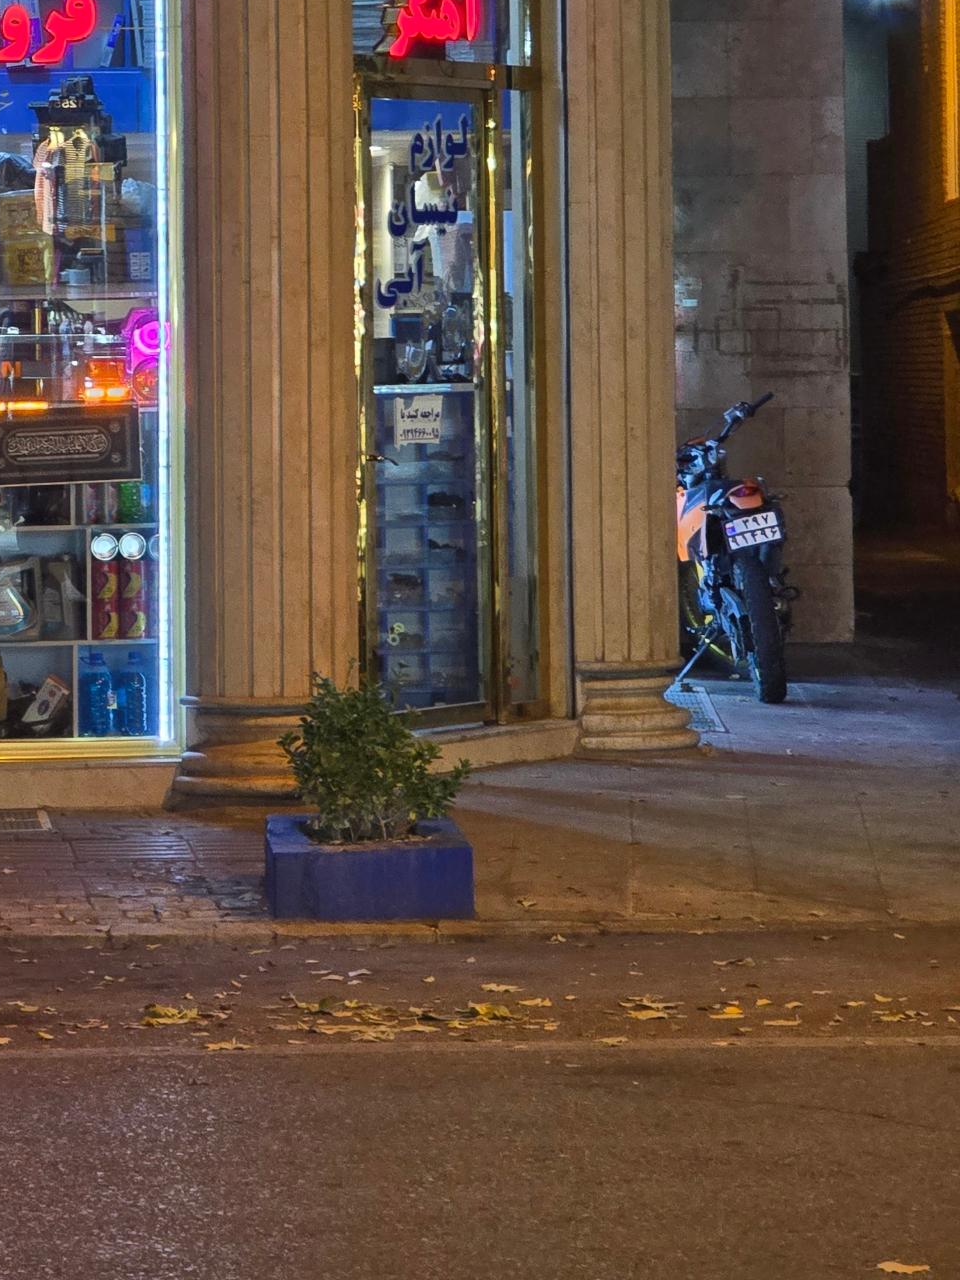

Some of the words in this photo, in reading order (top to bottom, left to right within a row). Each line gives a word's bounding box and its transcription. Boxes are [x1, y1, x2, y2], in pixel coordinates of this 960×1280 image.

[410, 113, 469, 174] لوازم
[387, 180, 460, 238] نیسان
[376, 238, 428, 309] آبی
[420, 407, 440, 422] مراجعه
